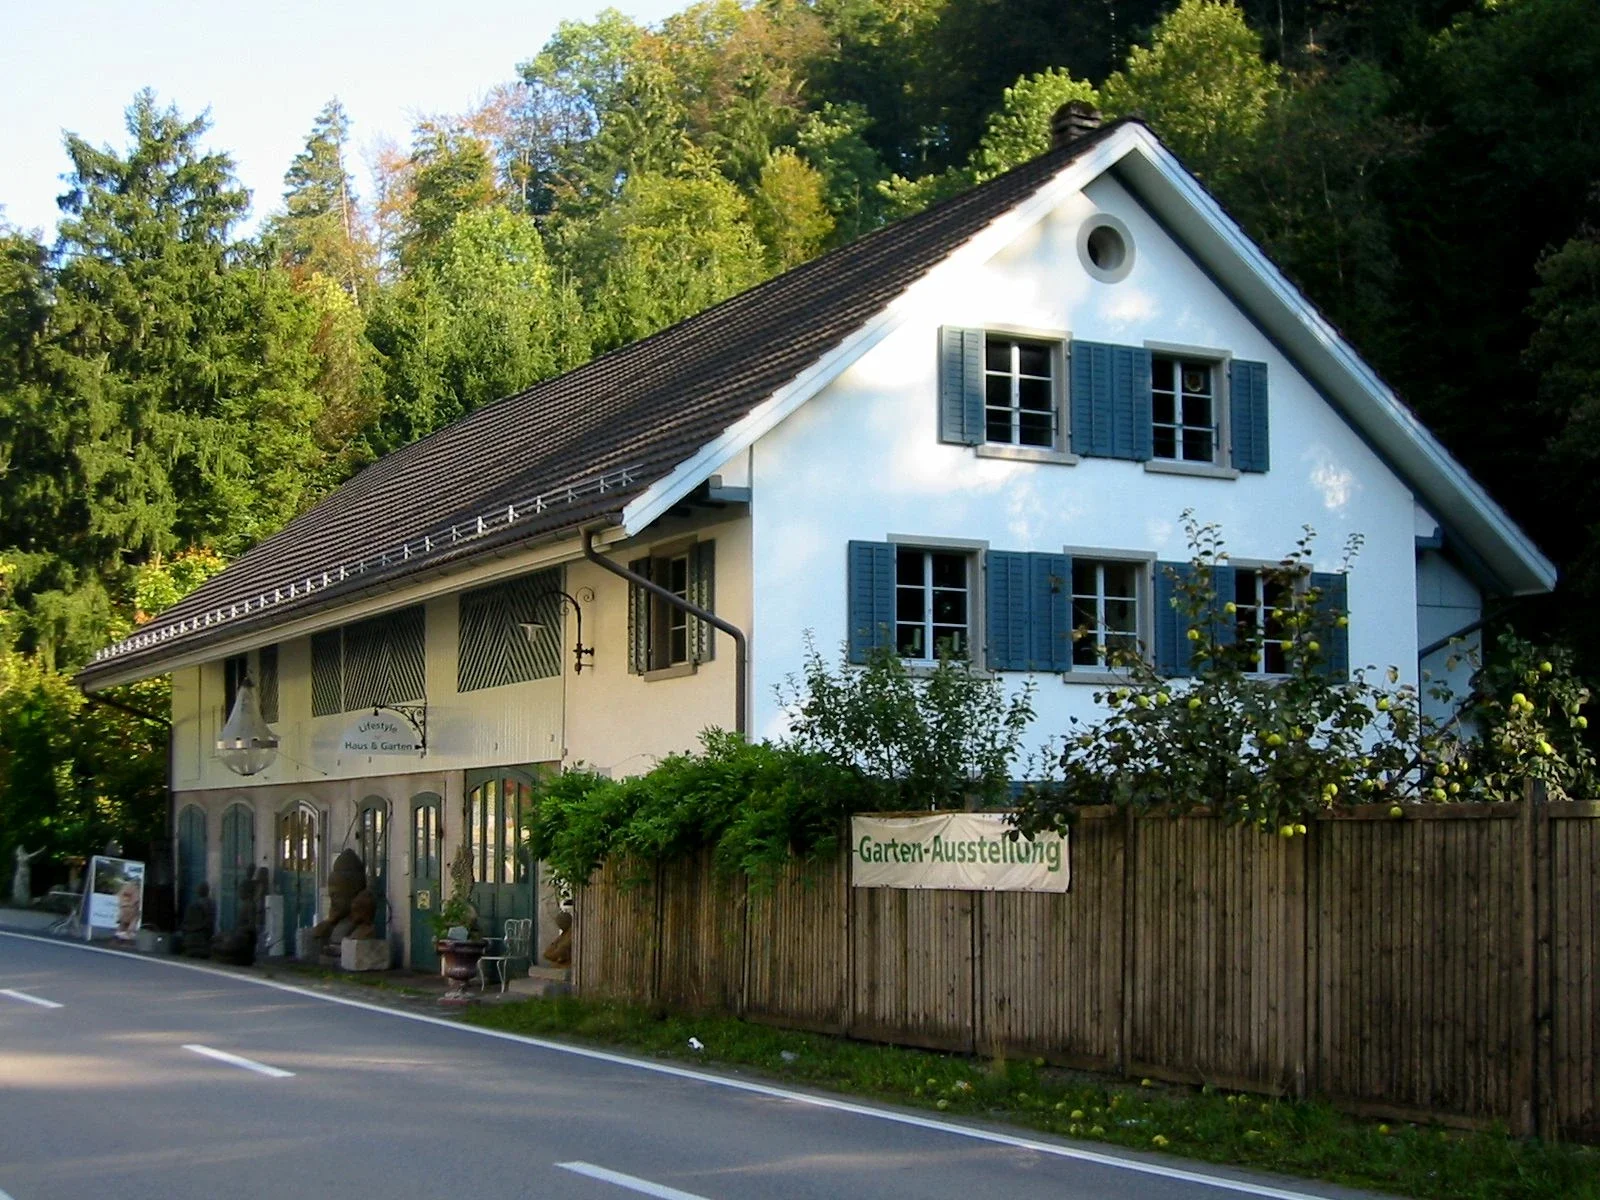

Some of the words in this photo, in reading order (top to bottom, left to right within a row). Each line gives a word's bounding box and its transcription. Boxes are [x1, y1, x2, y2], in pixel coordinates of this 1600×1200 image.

[359, 722, 398, 734] Lifestyle
[345, 742, 368, 750] Haus
[371, 742, 378, 750] &
[381, 742, 413, 751] Garten
[859, 834, 1061, 872] Garten-Ausstellung
